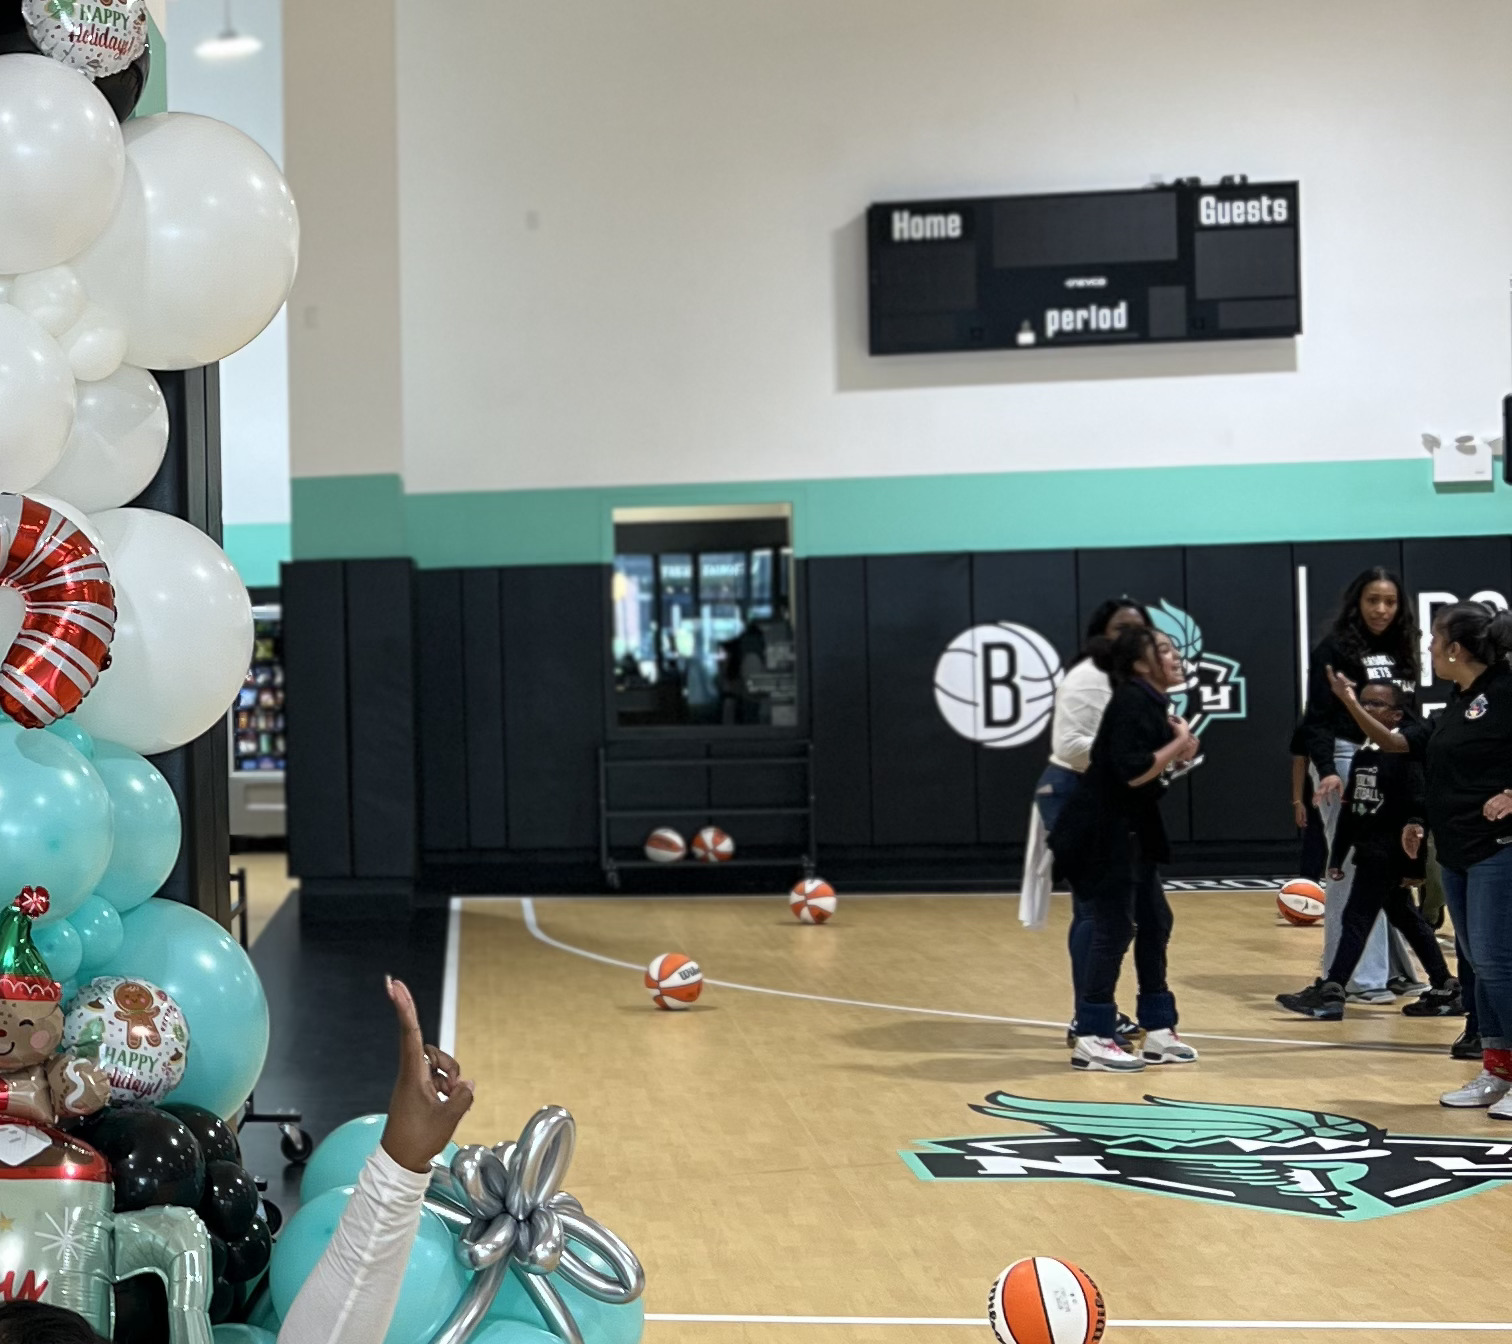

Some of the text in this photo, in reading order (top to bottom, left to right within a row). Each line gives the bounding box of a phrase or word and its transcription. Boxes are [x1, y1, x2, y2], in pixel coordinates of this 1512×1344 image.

[79, 4, 131, 30] HAPPY
[892, 210, 963, 242] Home
[1199, 195, 1288, 226] Guests
[1046, 301, 1128, 339] period
[982, 641, 1021, 729] B
[104, 1045, 159, 1073] HAPPY
